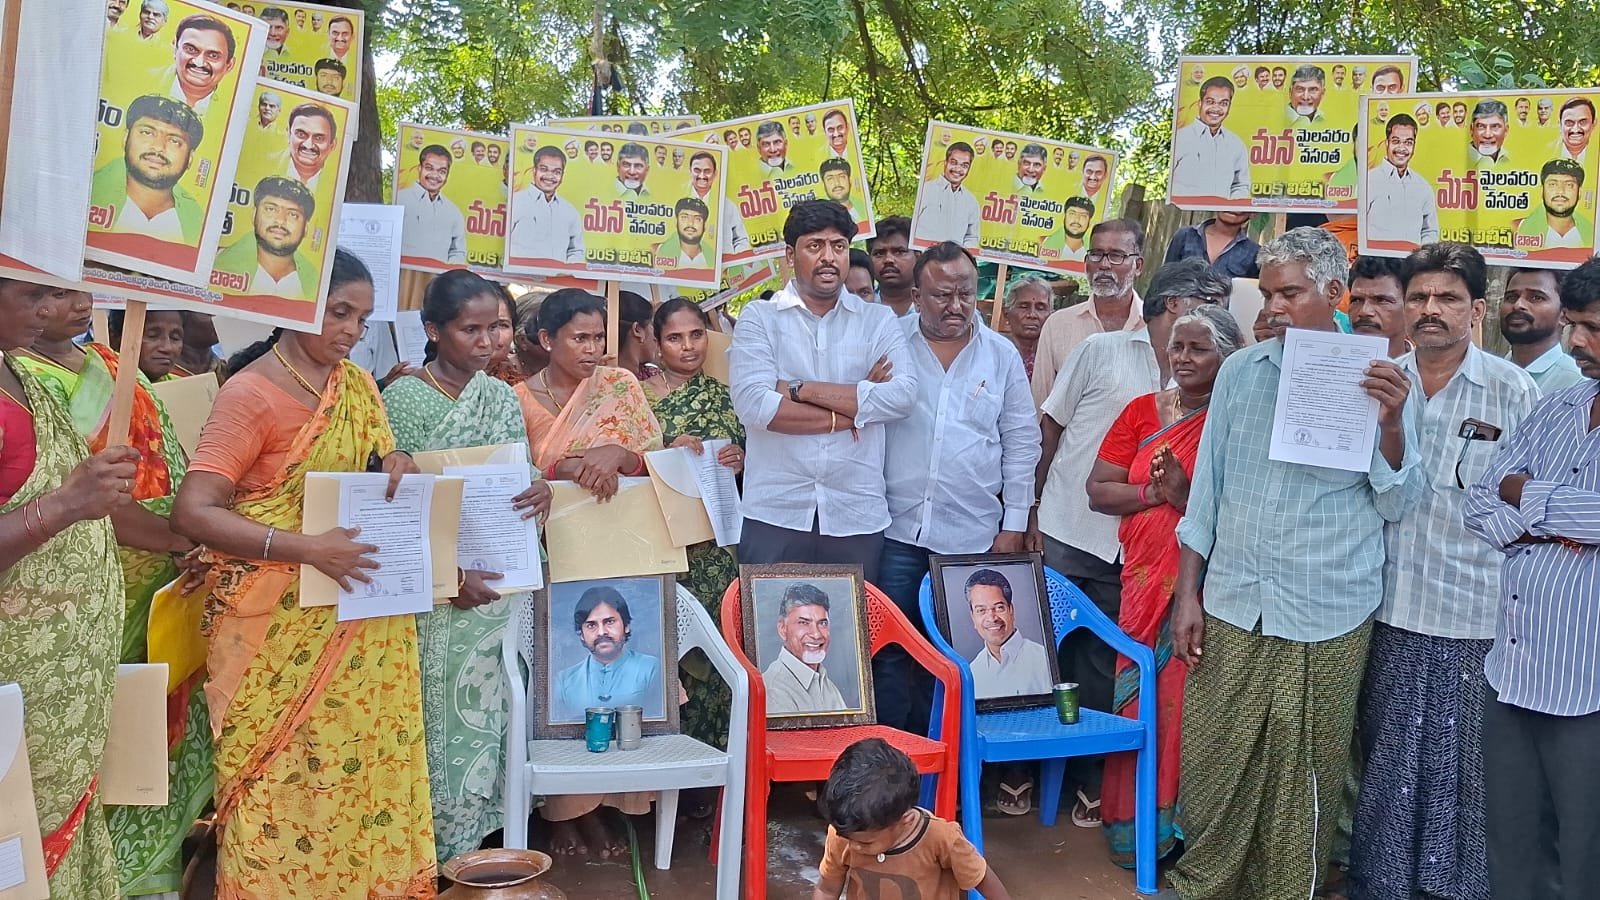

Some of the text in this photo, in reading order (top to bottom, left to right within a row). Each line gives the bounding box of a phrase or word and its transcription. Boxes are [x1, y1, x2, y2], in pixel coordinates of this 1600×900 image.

[267, 60, 313, 76] మైలవరం
[1250, 128, 1294, 165] మన
[1296, 128, 1350, 148] మైలవరం
[1300, 147, 1341, 164] వసంత
[774, 172, 820, 196] మైలవరం
[1251, 182, 1284, 196] లంక
[1437, 169, 1478, 210] మన
[1480, 170, 1538, 191] మైలవరం
[625, 200, 674, 218] మైలవరం
[738, 180, 777, 219] మన
[982, 191, 1018, 225] మన
[1020, 196, 1063, 214] మైలవరం
[1485, 191, 1529, 210] వసంత
[466, 199, 507, 238] మన
[583, 197, 624, 234] మన
[1021, 211, 1054, 230] వసంత
[629, 218, 666, 236] వసంత
[1440, 227, 1471, 244] లంక
[586, 249, 616, 263] లంక
[209, 270, 249, 292] బాబి)
